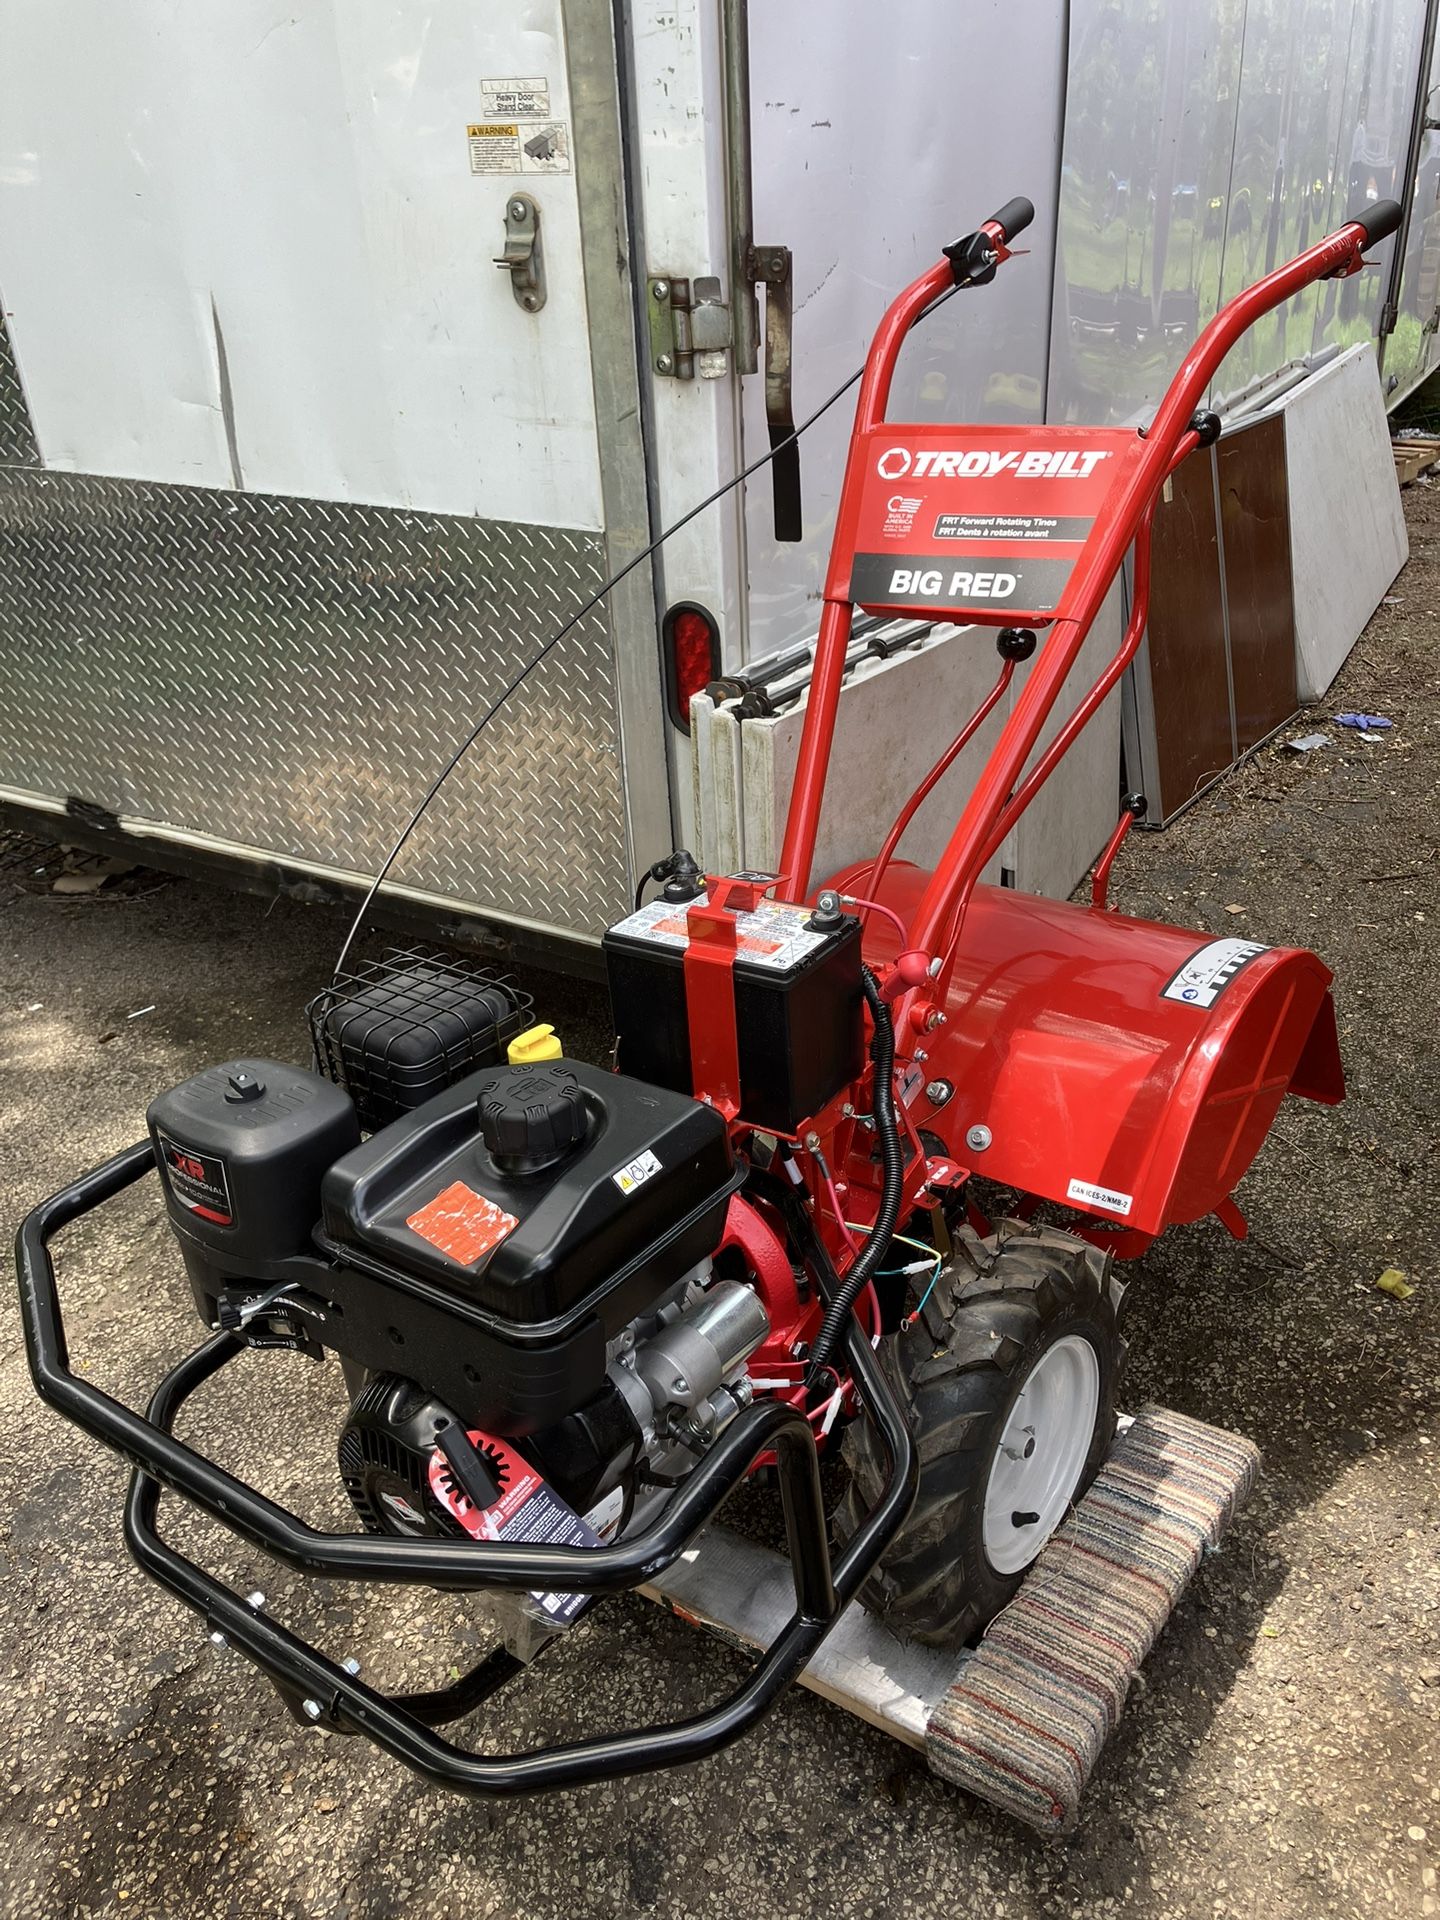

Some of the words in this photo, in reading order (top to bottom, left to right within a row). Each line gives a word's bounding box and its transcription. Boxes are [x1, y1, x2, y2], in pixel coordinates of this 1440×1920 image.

[496, 94, 516, 103] Heavy
[518, 93, 534, 101] Door
[497, 103, 516, 111] Stand
[518, 103, 535, 111] Clear
[477, 126, 513, 136] WARNING
[912, 450, 1107, 478] TROY-BILT
[942, 516, 960, 525] FRT
[960, 517, 995, 526] Forward
[996, 517, 1032, 527] Rotating
[1034, 518, 1057, 527] Tines
[939, 527, 956, 536] FRT
[957, 528, 982, 536] Dents
[982, 528, 988, 536] à
[990, 529, 1024, 537] rotation
[1024, 530, 1049, 538] avant
[889, 569, 943, 596] BIG
[948, 571, 1017, 598] RED
[170, 1150, 207, 1183] XR
[1071, 1185, 1085, 1195] CAN
[1086, 1190, 1128, 1208] ICES-2/NMB-2
[498, 1475, 531, 1509] WARNING
